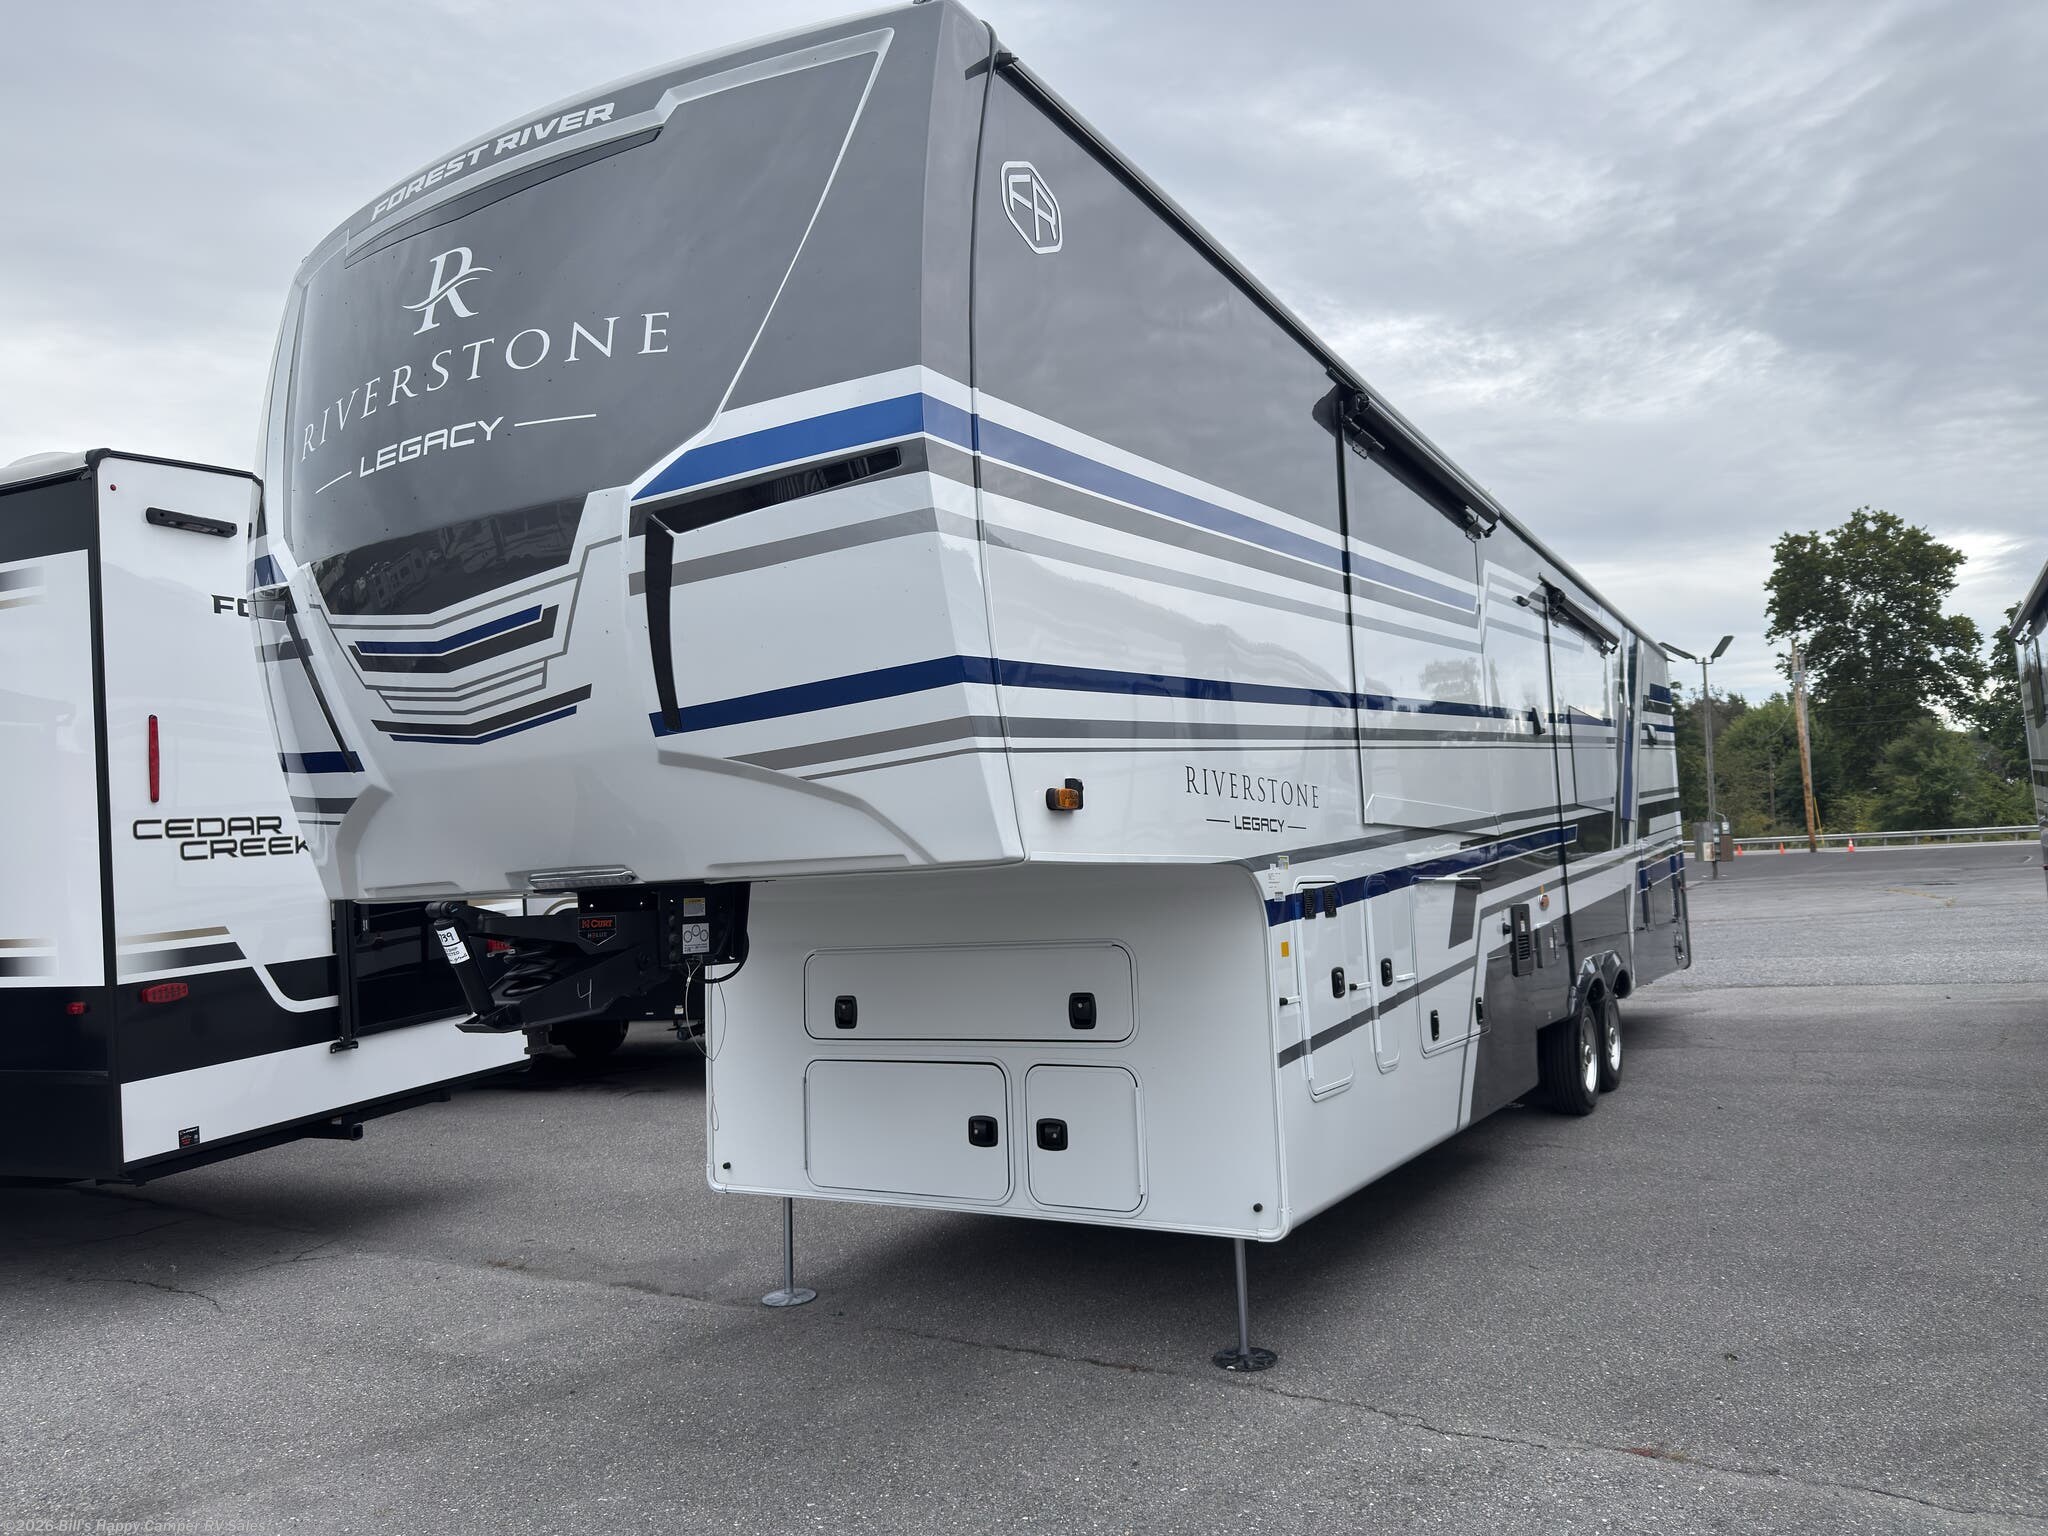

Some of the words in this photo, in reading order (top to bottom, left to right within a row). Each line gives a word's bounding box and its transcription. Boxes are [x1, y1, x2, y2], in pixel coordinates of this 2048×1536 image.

[371, 145, 489, 221] FOREST
[494, 102, 615, 156] RIVER
[301, 312, 671, 462] RIVERSTONE
[359, 416, 504, 477] LEGACY
[1185, 765, 1320, 809] RIVERSTONE
[133, 816, 283, 840] CEDAR
[1234, 815, 1285, 832] LEGACY
[180, 835, 309, 861] CREEK
